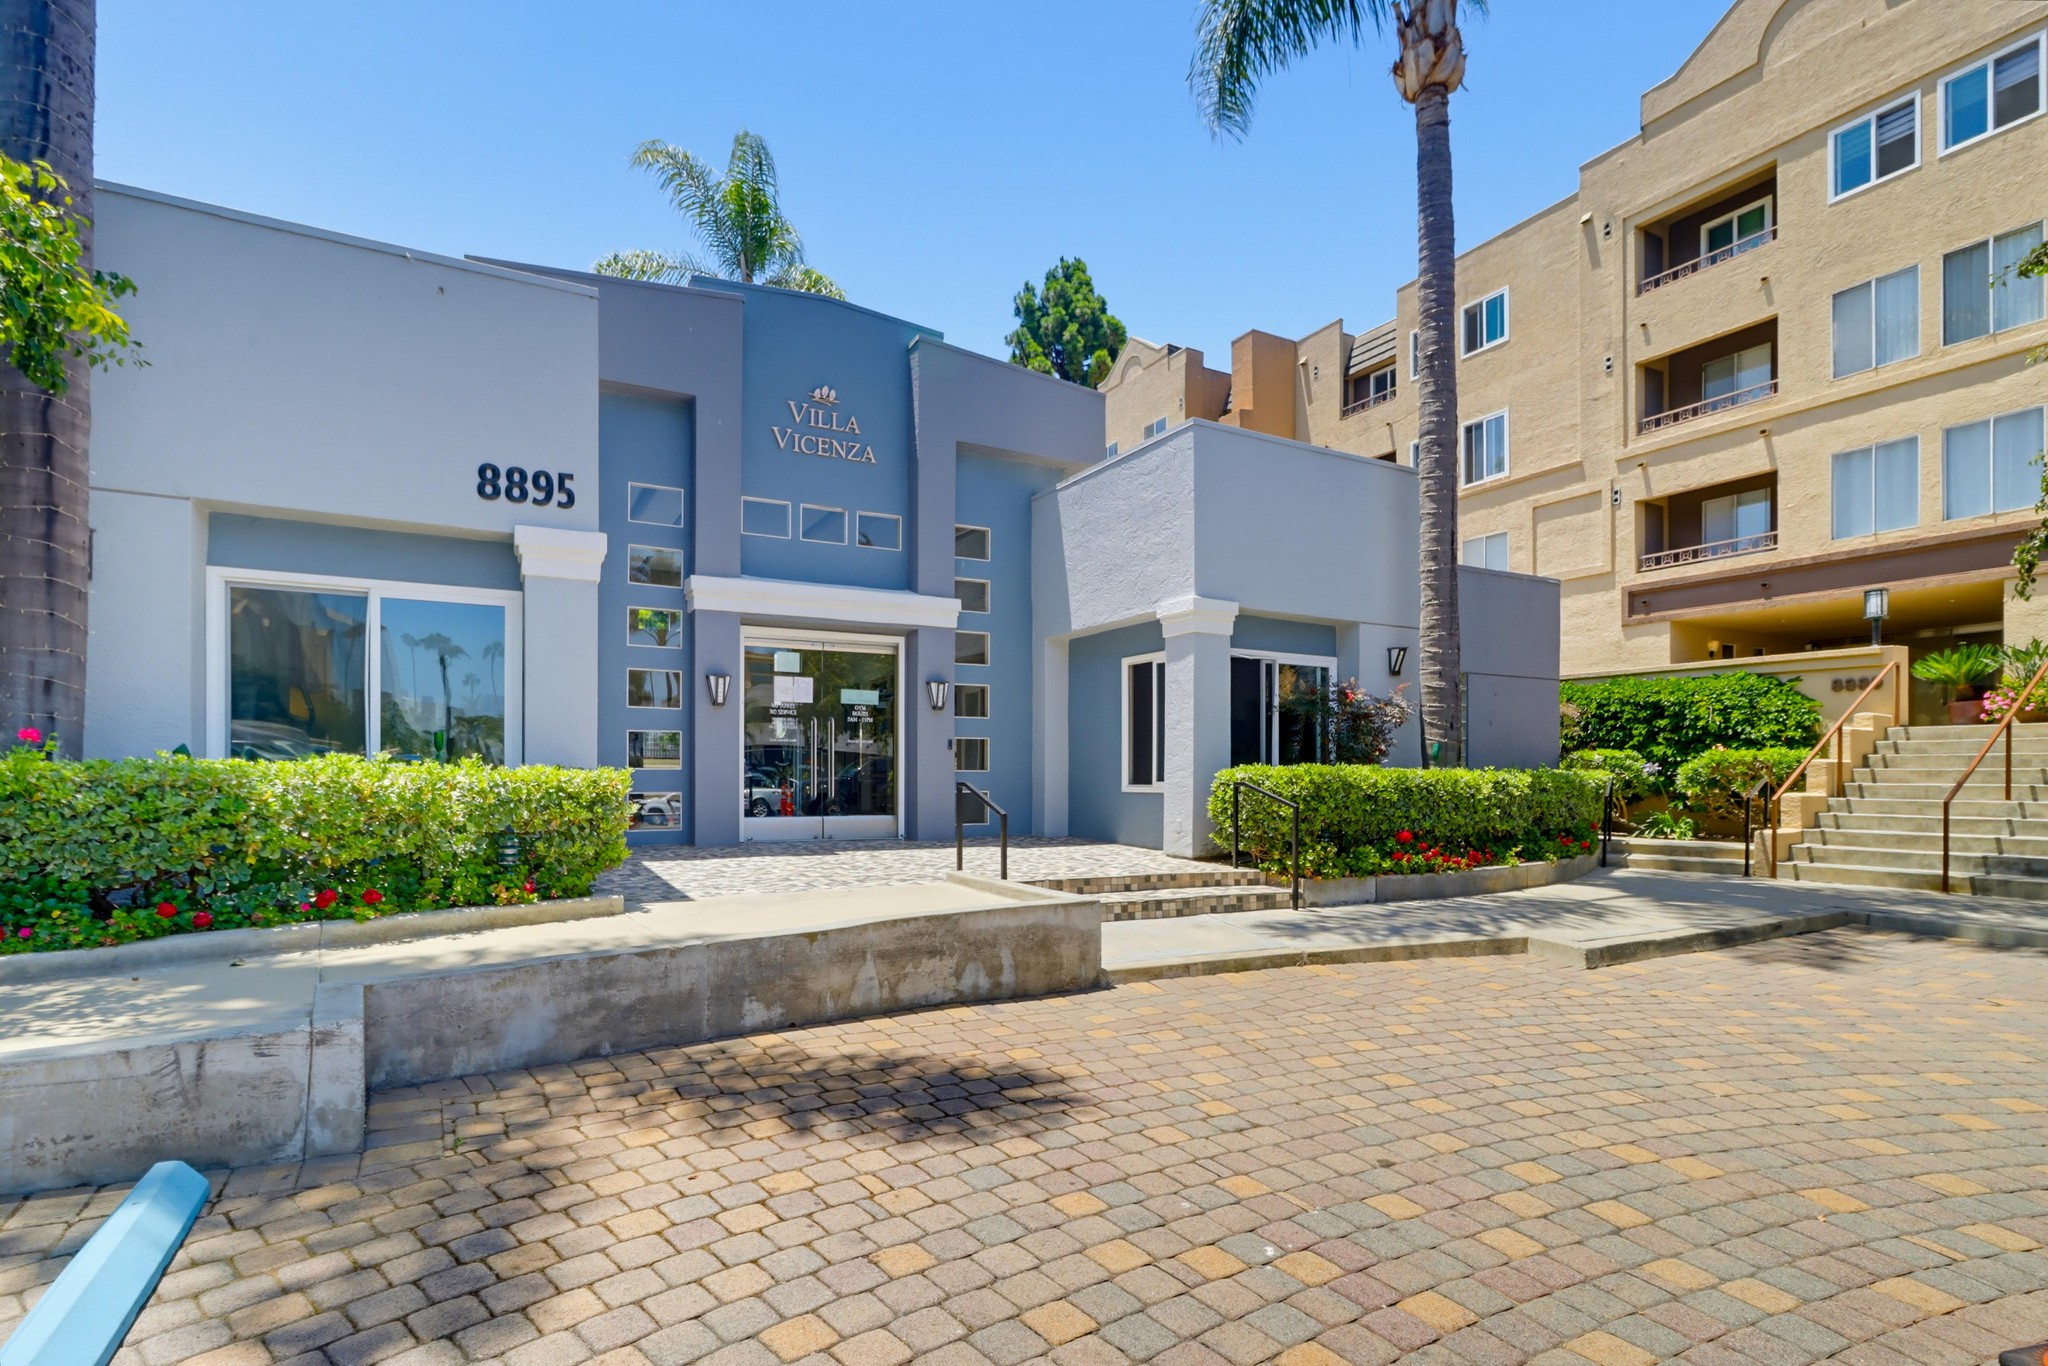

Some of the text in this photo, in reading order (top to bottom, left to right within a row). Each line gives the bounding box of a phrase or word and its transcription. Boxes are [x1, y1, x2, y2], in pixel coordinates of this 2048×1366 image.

[787, 400, 861, 435] VILLA
[771, 426, 877, 464] VICENZA
[476, 462, 576, 510] 8895
